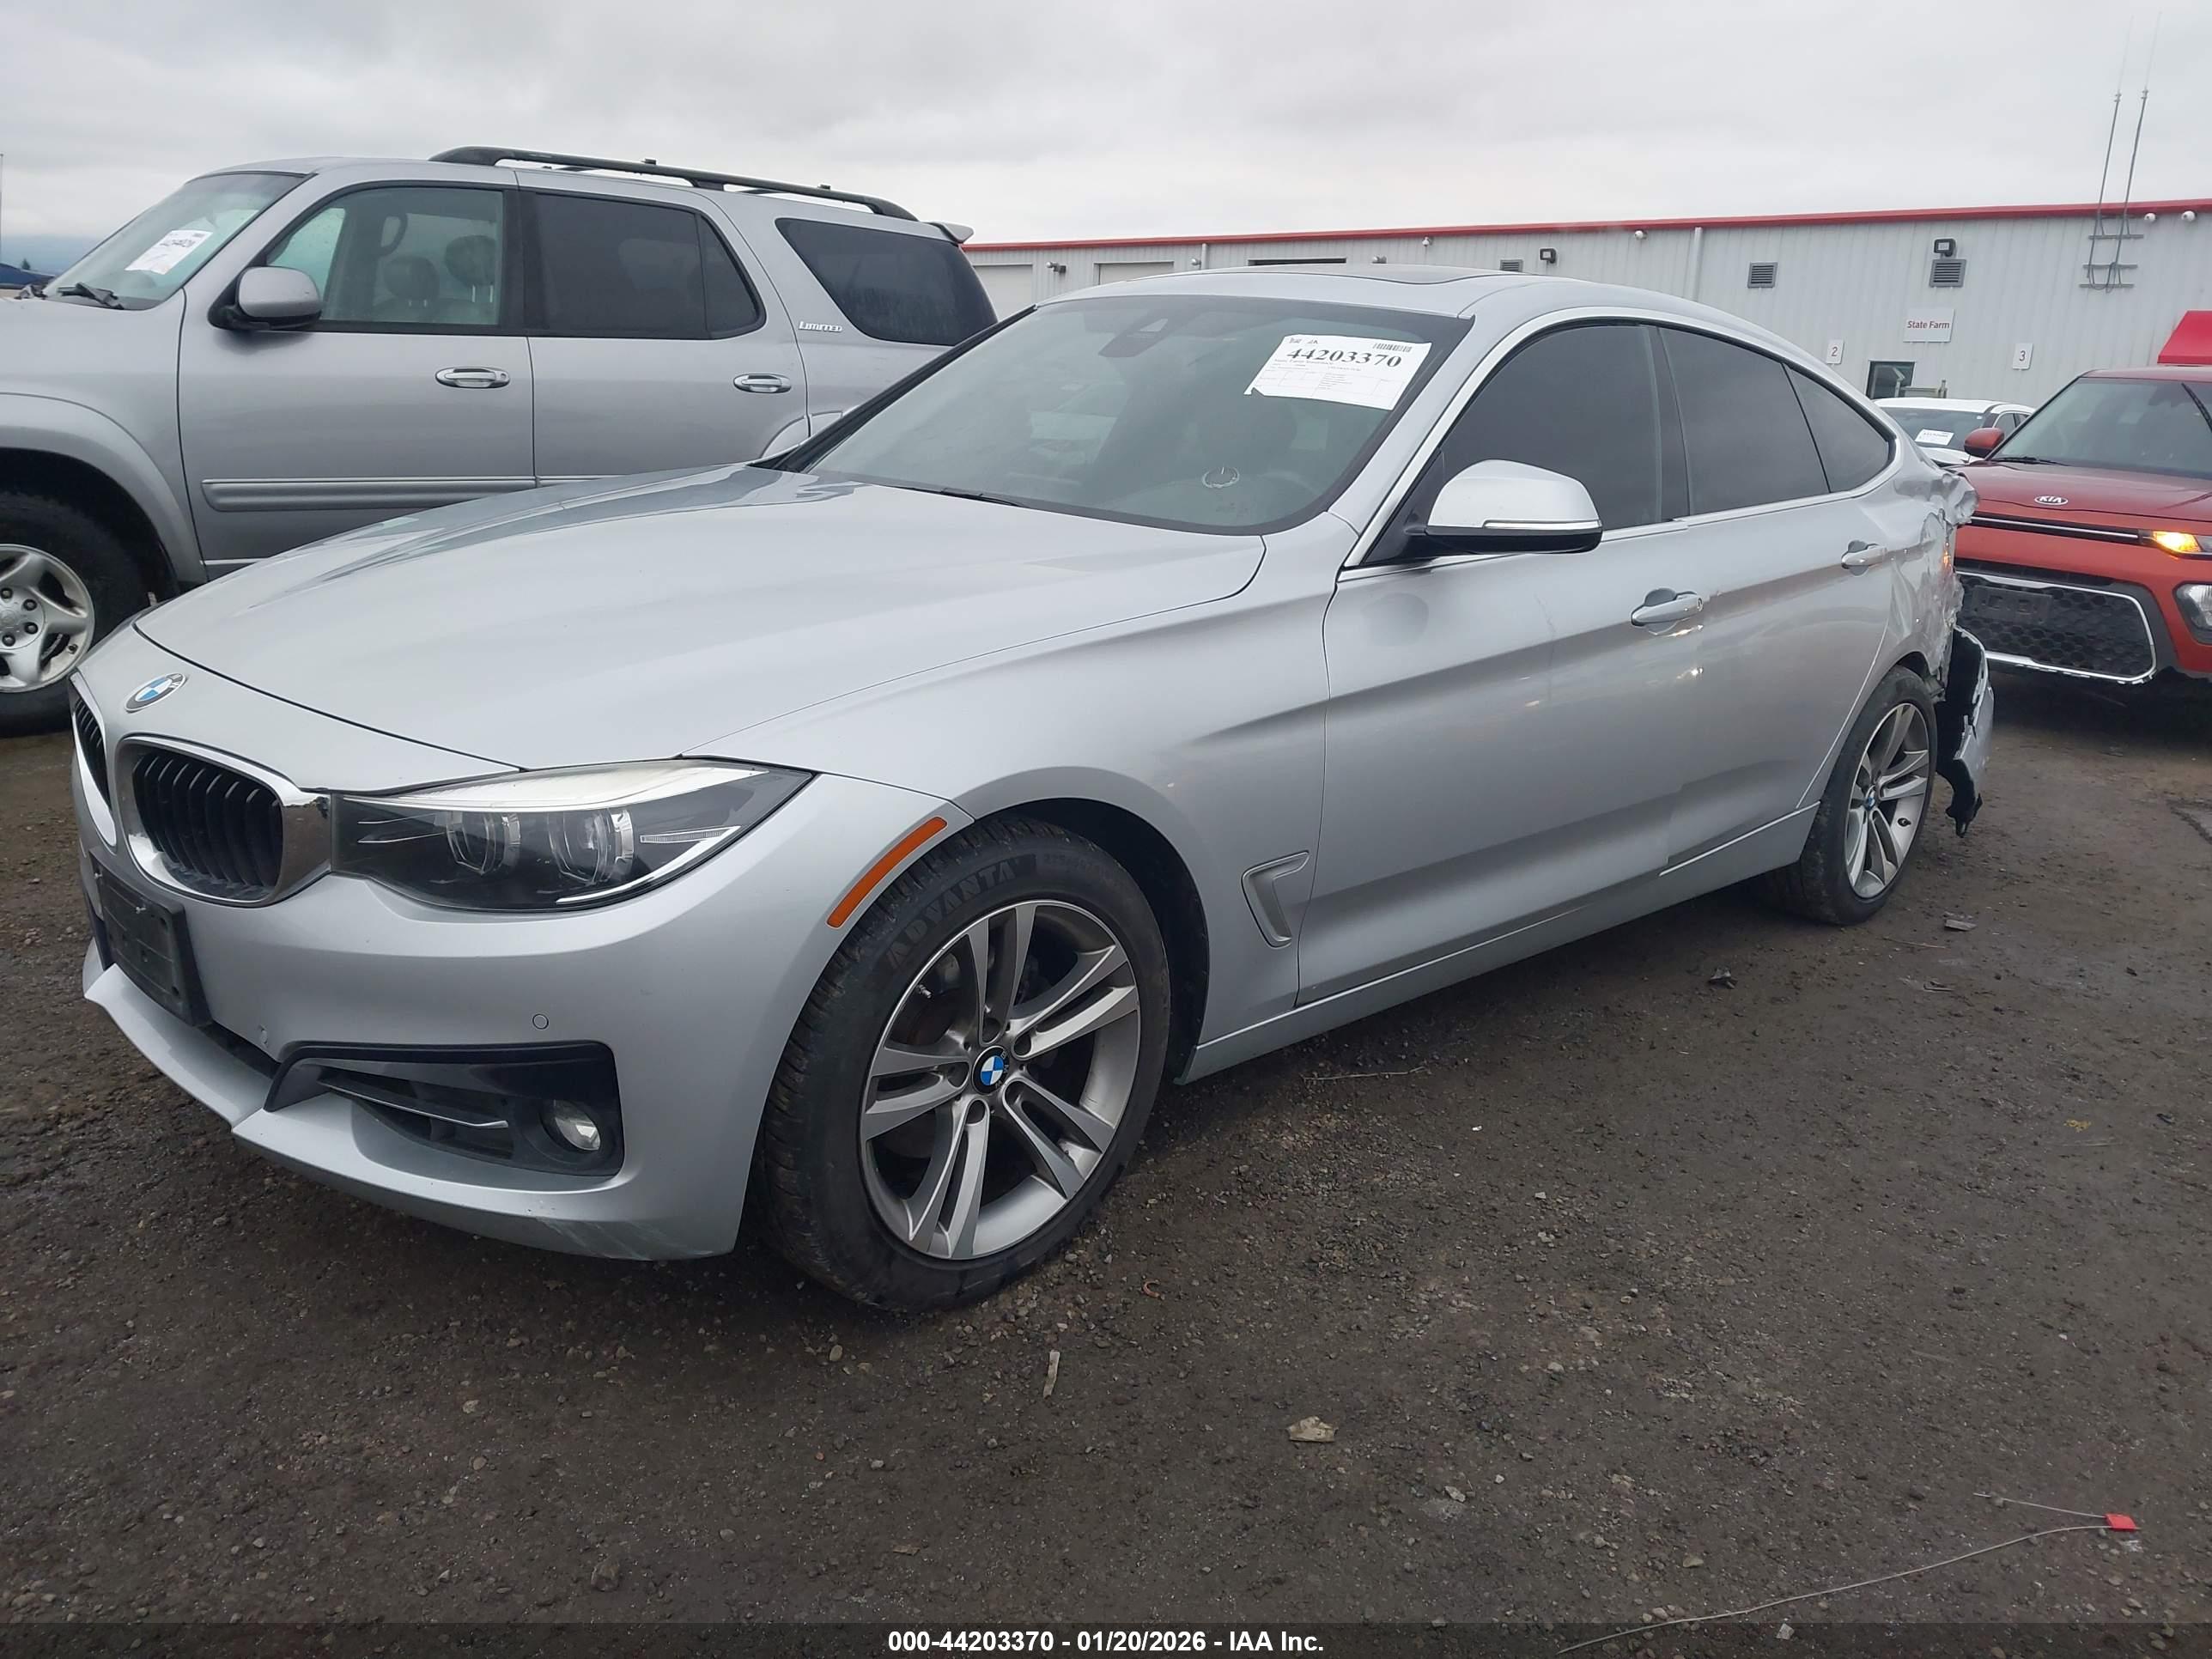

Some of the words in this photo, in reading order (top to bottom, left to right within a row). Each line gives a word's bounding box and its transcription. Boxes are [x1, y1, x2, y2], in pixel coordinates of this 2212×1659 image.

[1907, 320, 1928, 330] State
[1929, 321, 1950, 330] Farm
[1831, 346, 1839, 357] 2
[2019, 350, 2027, 362] 3
[1287, 348, 1402, 368] 44203370
[887, 861, 1017, 968] ADVANTA
